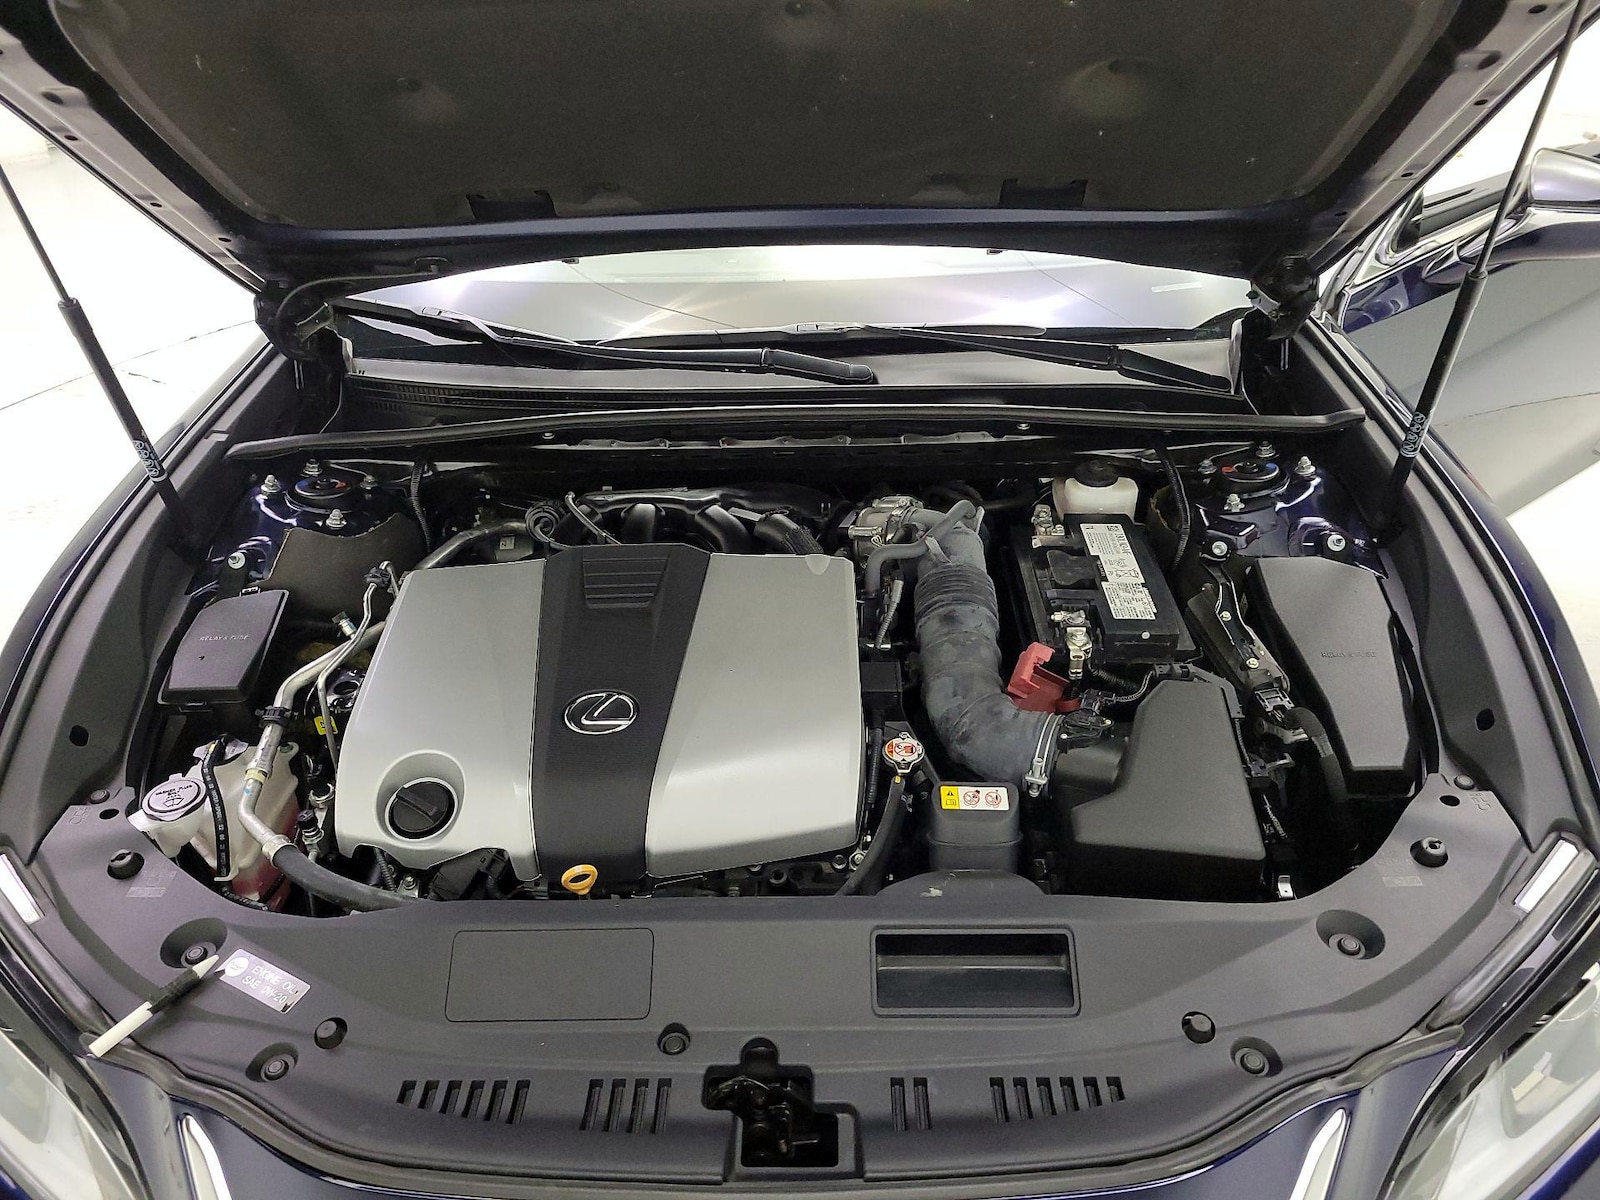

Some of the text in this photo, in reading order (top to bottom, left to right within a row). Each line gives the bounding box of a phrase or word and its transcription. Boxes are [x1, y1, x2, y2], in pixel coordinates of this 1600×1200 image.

[242, 974, 288, 1004] SAE 0W-20
[251, 965, 283, 985] ENGINE
[282, 980, 297, 996] OIL
